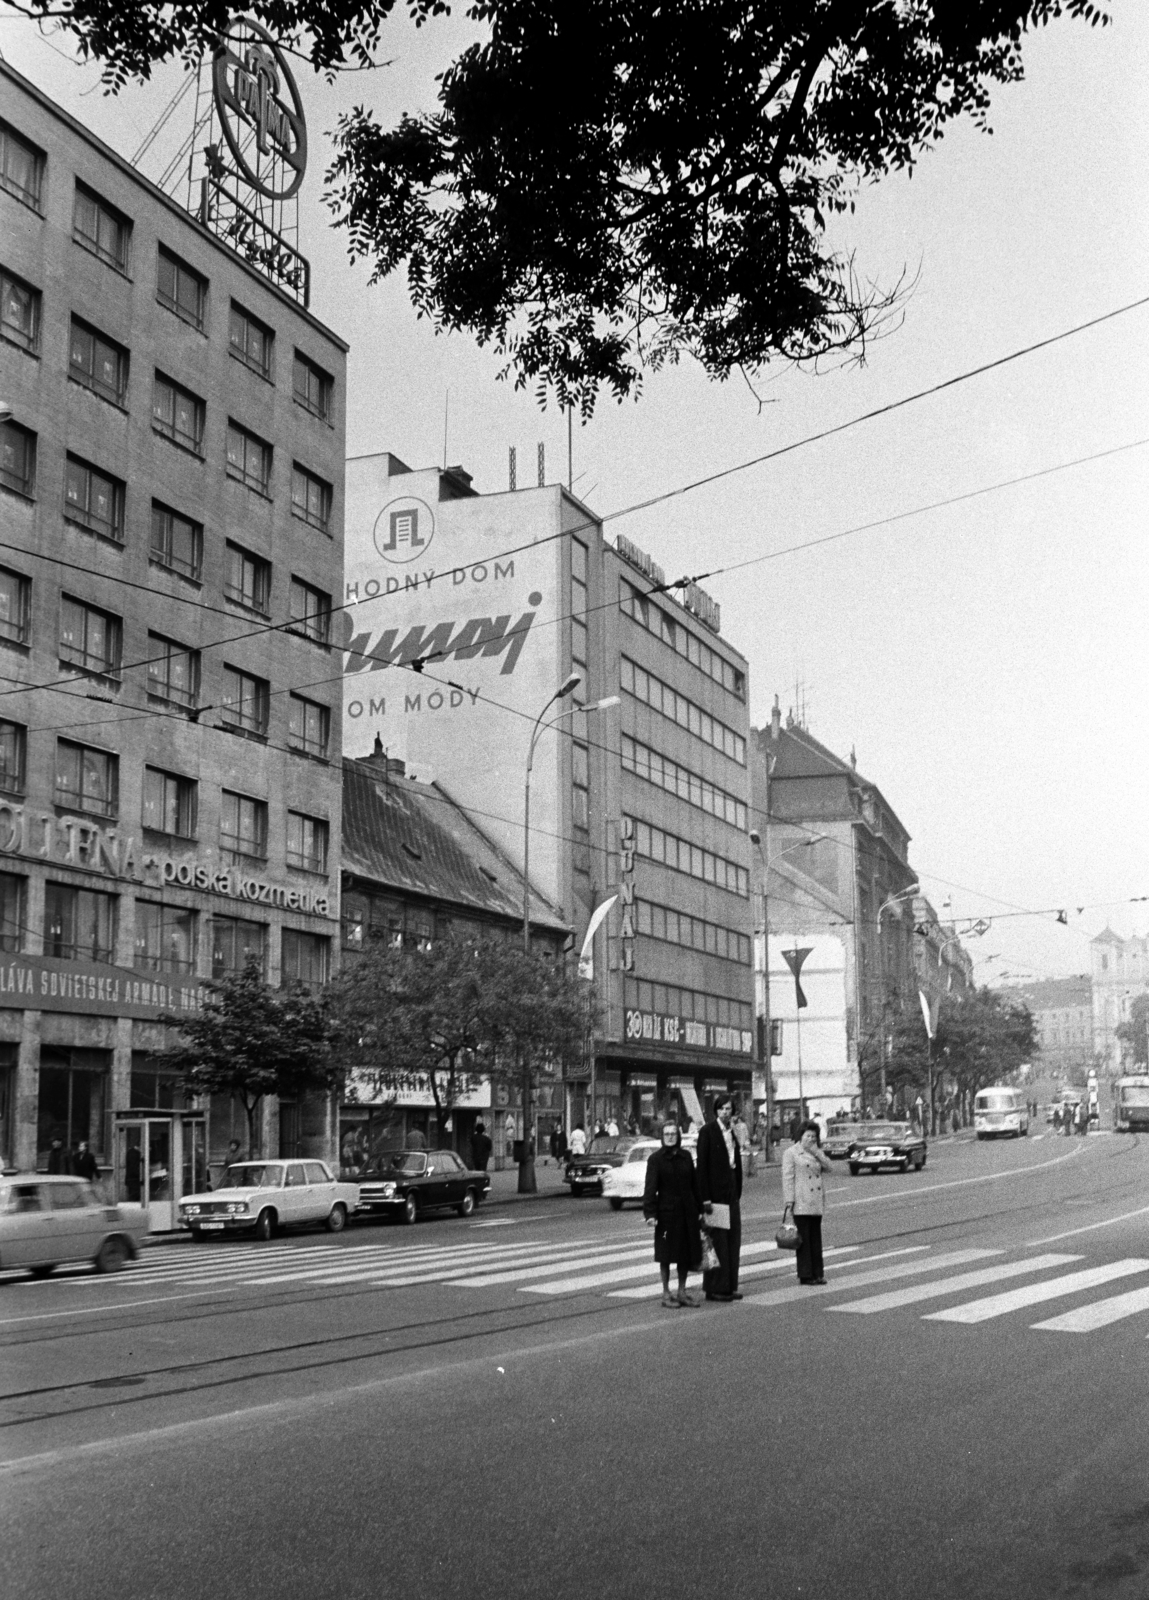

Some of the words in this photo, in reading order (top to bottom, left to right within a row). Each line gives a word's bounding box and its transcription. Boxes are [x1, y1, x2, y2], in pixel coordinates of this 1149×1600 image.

[452, 560, 515, 586] DOM
[404, 687, 481, 713] MÓDY
[236, 873, 330, 916] kozmetika
[619, 817, 635, 972] DUNAJ
[41, 970, 119, 1002] SOVIETSKEJ
